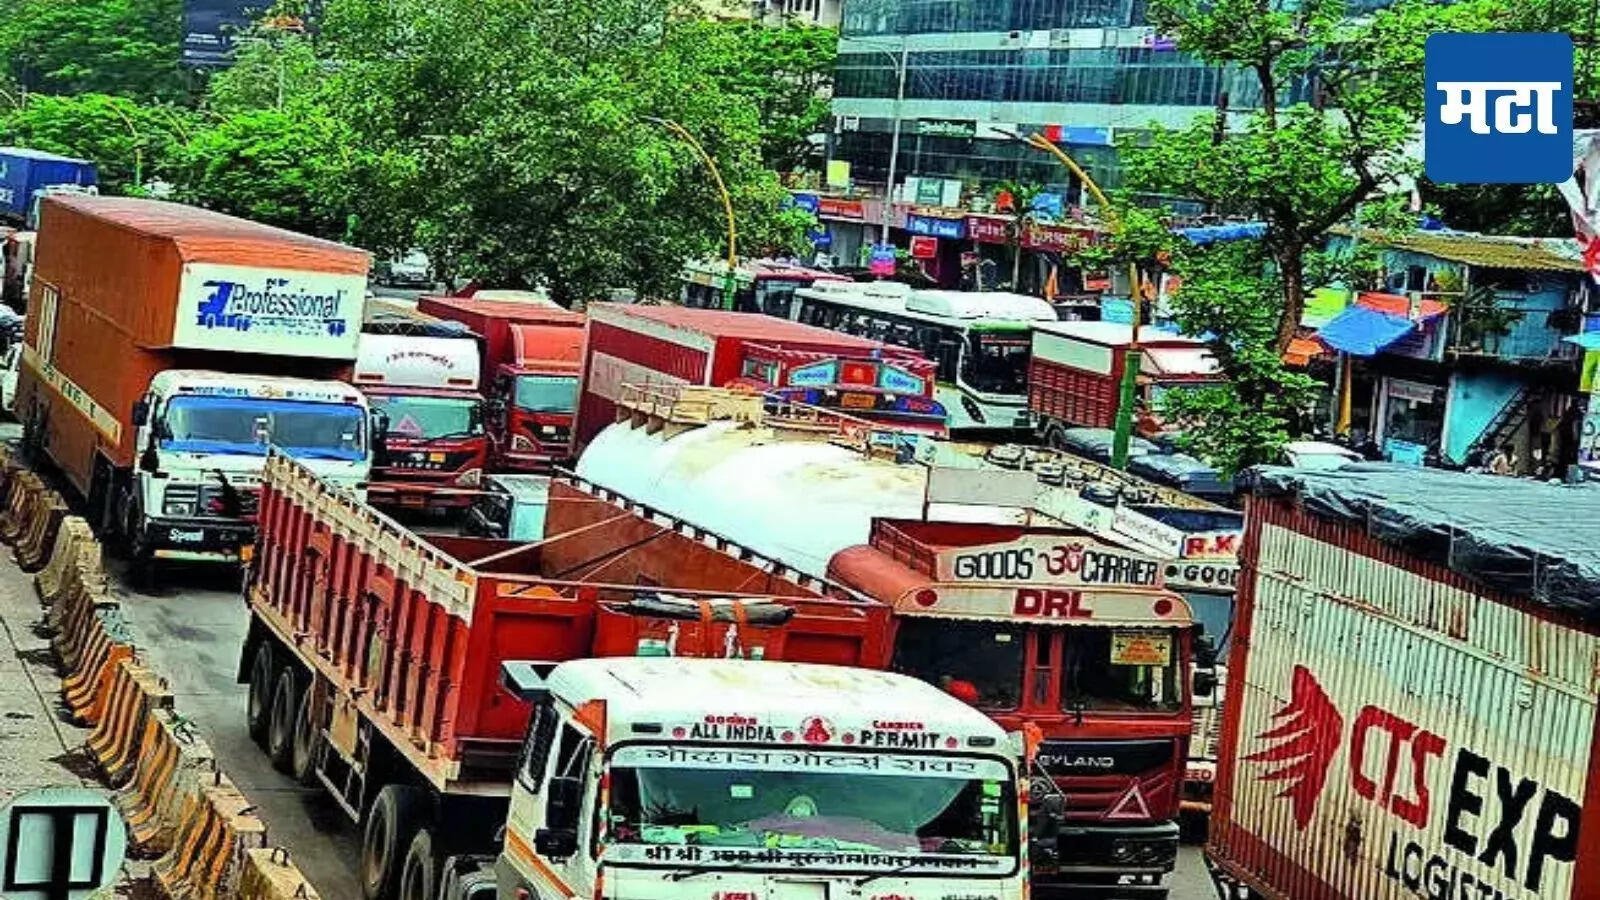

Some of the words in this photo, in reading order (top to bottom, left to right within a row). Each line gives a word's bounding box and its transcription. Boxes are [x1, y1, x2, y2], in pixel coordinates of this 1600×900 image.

[232, 284, 343, 318] Professional
[955, 548, 1034, 580] GOODS
[1080, 550, 1158, 585] CARRIER
[1013, 588, 1093, 619] DRL
[690, 723, 720, 739] ALL
[726, 725, 776, 741] INDIA
[860, 729, 940, 748] PERMIT
[1039, 755, 1114, 768] EYLAND
